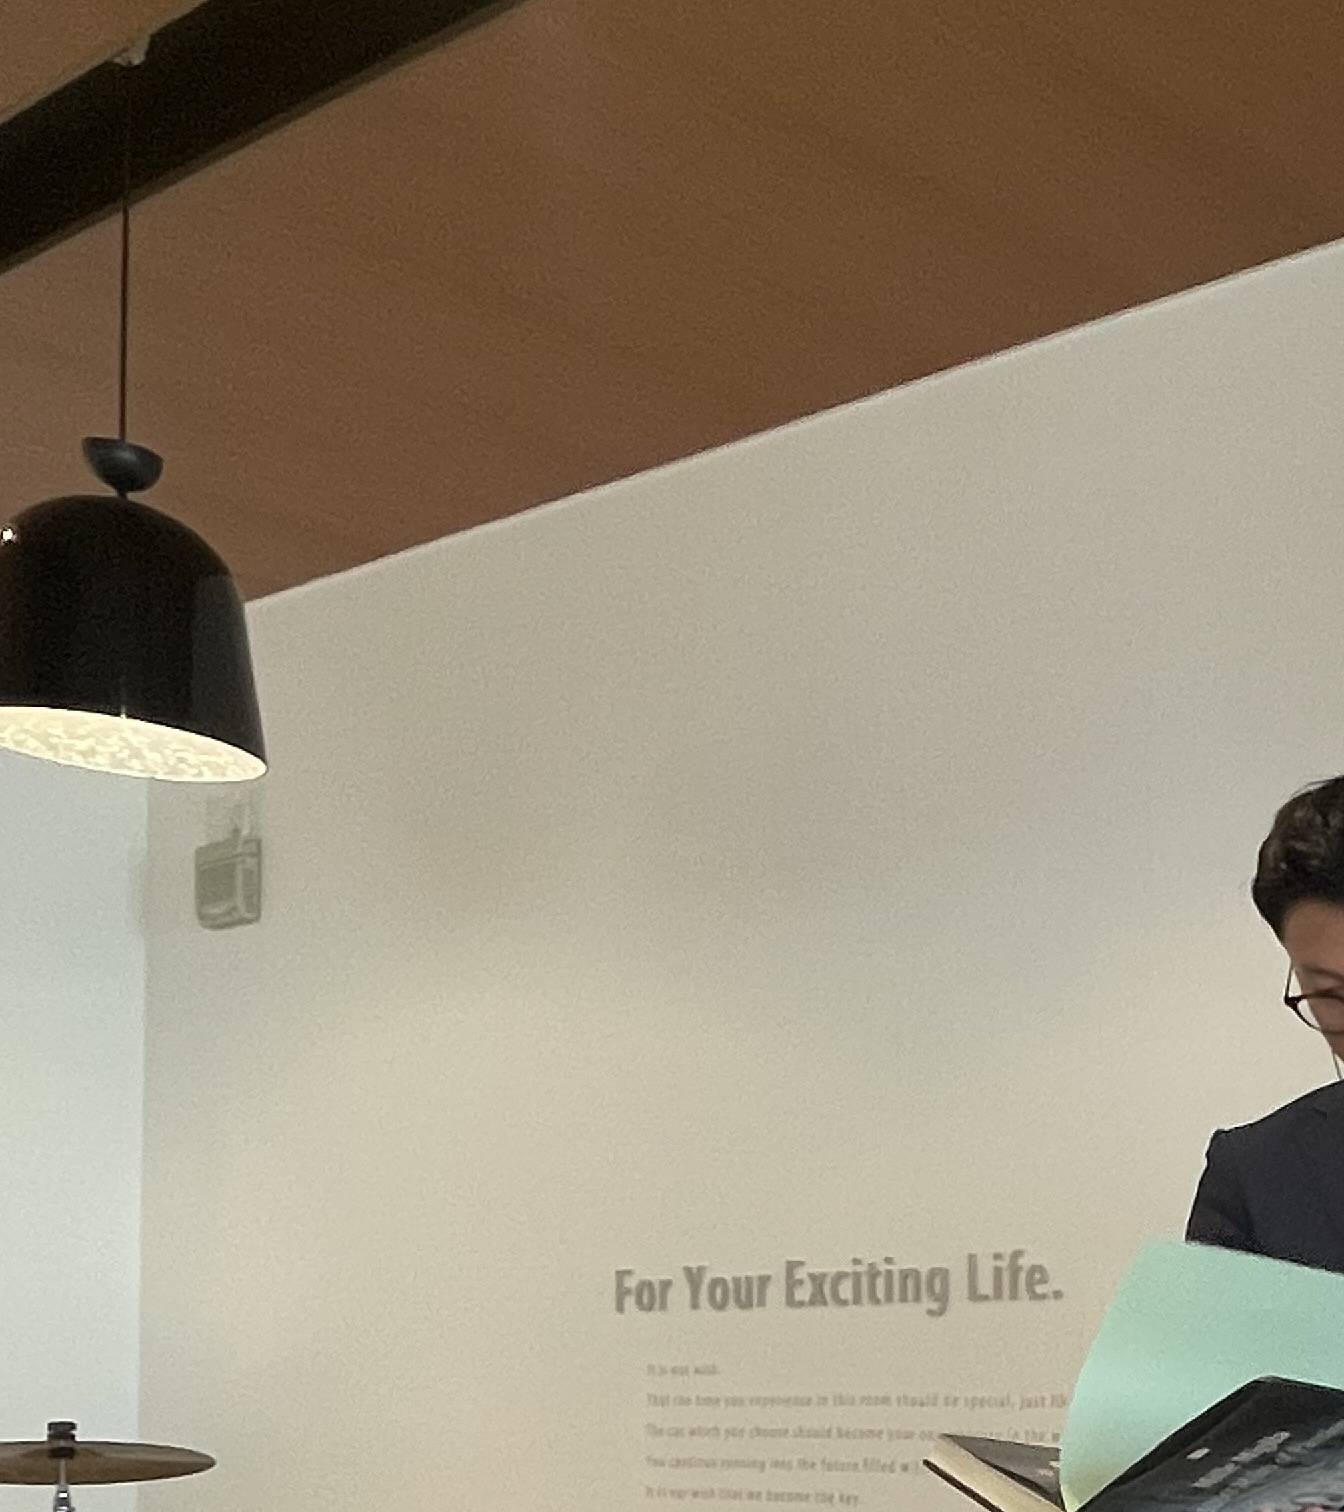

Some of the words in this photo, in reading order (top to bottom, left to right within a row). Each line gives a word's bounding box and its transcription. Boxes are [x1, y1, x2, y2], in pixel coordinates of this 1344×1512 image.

[614, 1268, 673, 1315] For
[684, 1264, 772, 1312] Your
[784, 1256, 950, 1318] Exciting
[967, 1248, 1064, 1304] Life.
